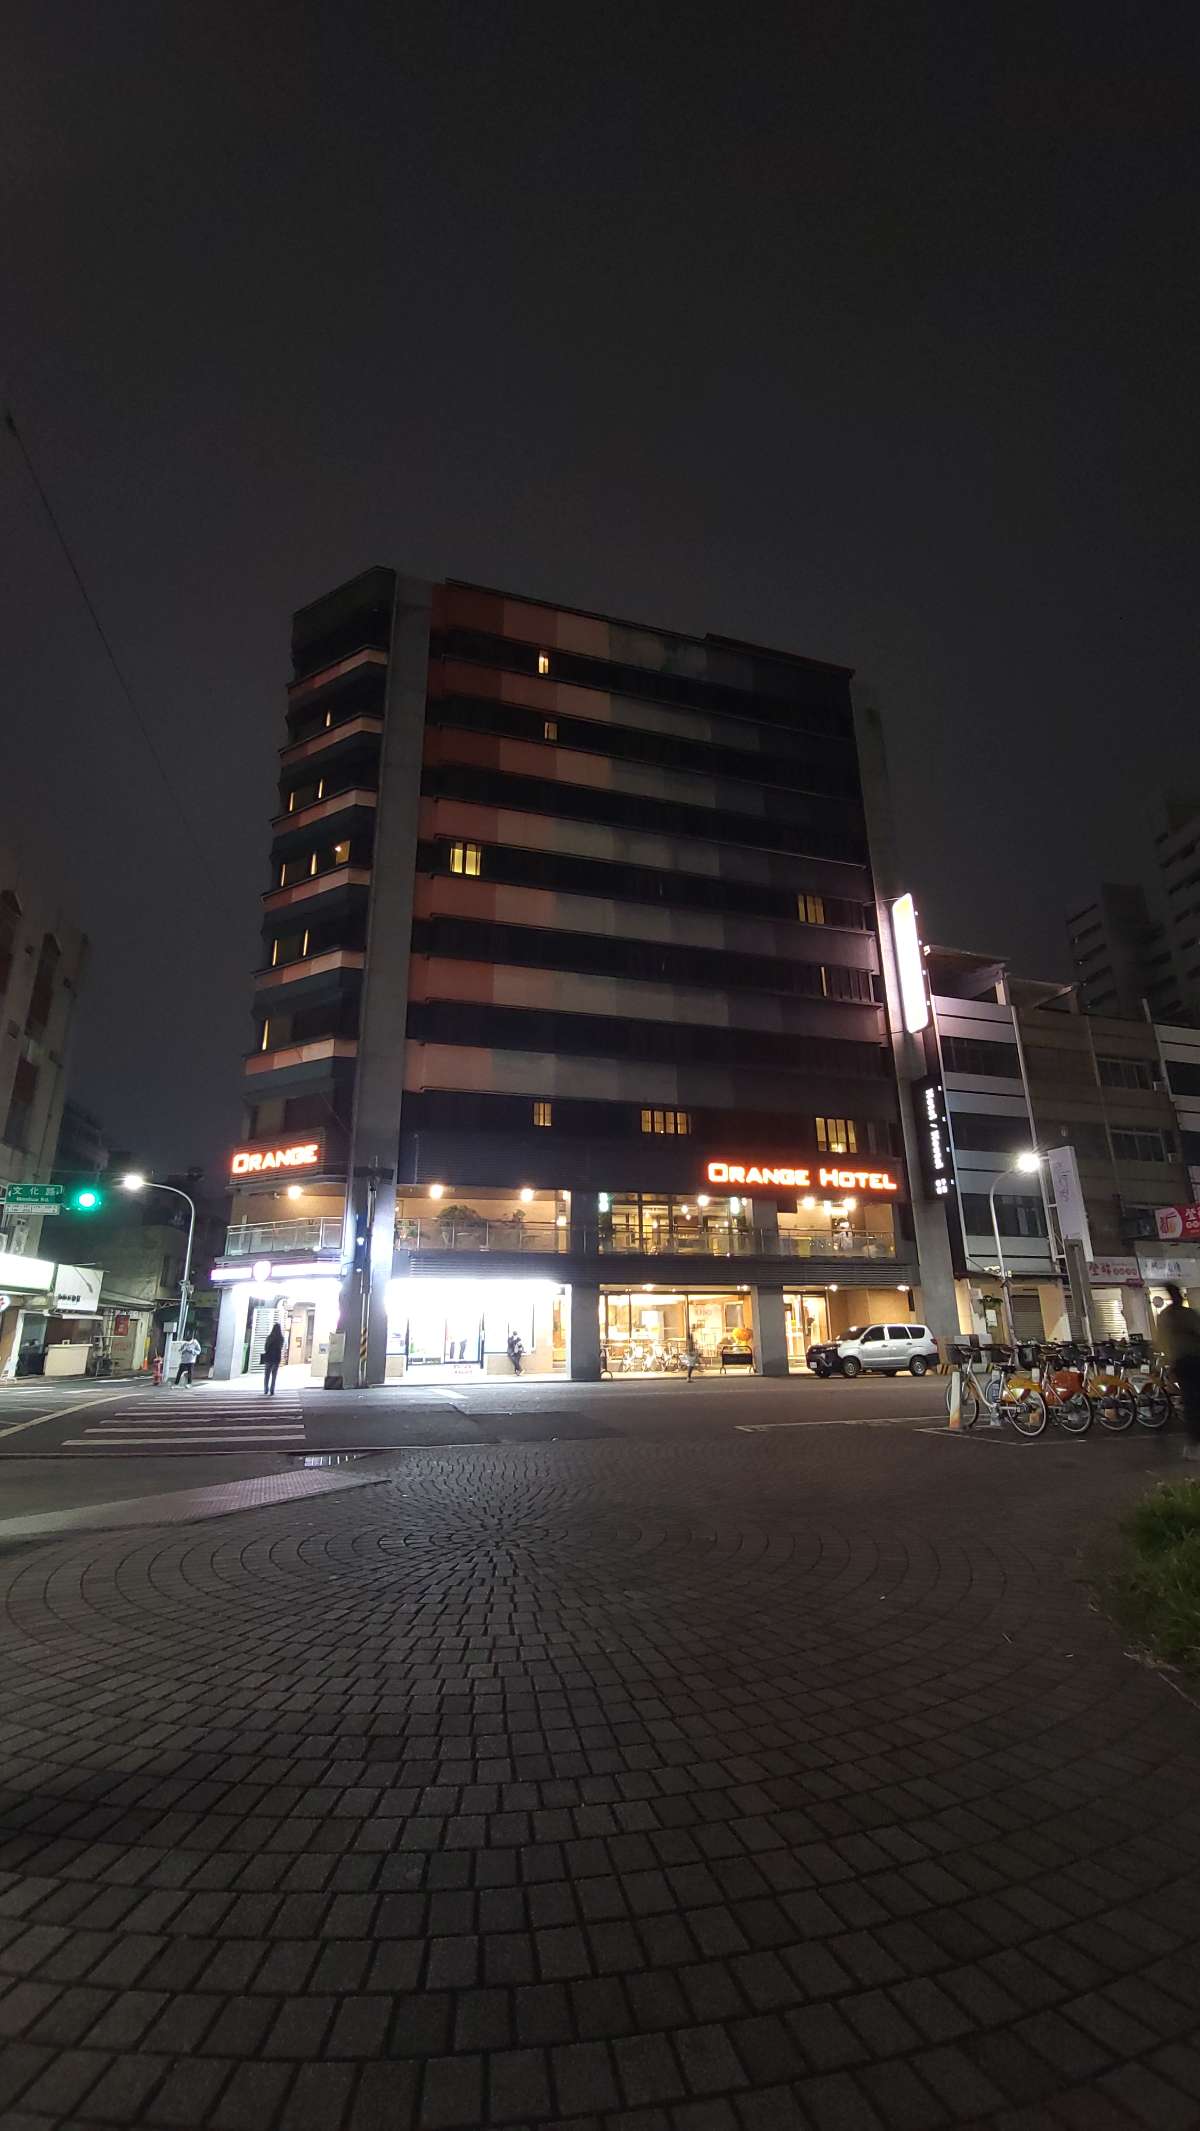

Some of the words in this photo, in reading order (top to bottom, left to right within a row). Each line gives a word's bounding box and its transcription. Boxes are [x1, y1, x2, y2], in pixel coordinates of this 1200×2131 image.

[231, 1144, 319, 1174] ORANGE
[707, 1162, 811, 1187] ORANGE
[819, 1167, 898, 1190] HOTEL
